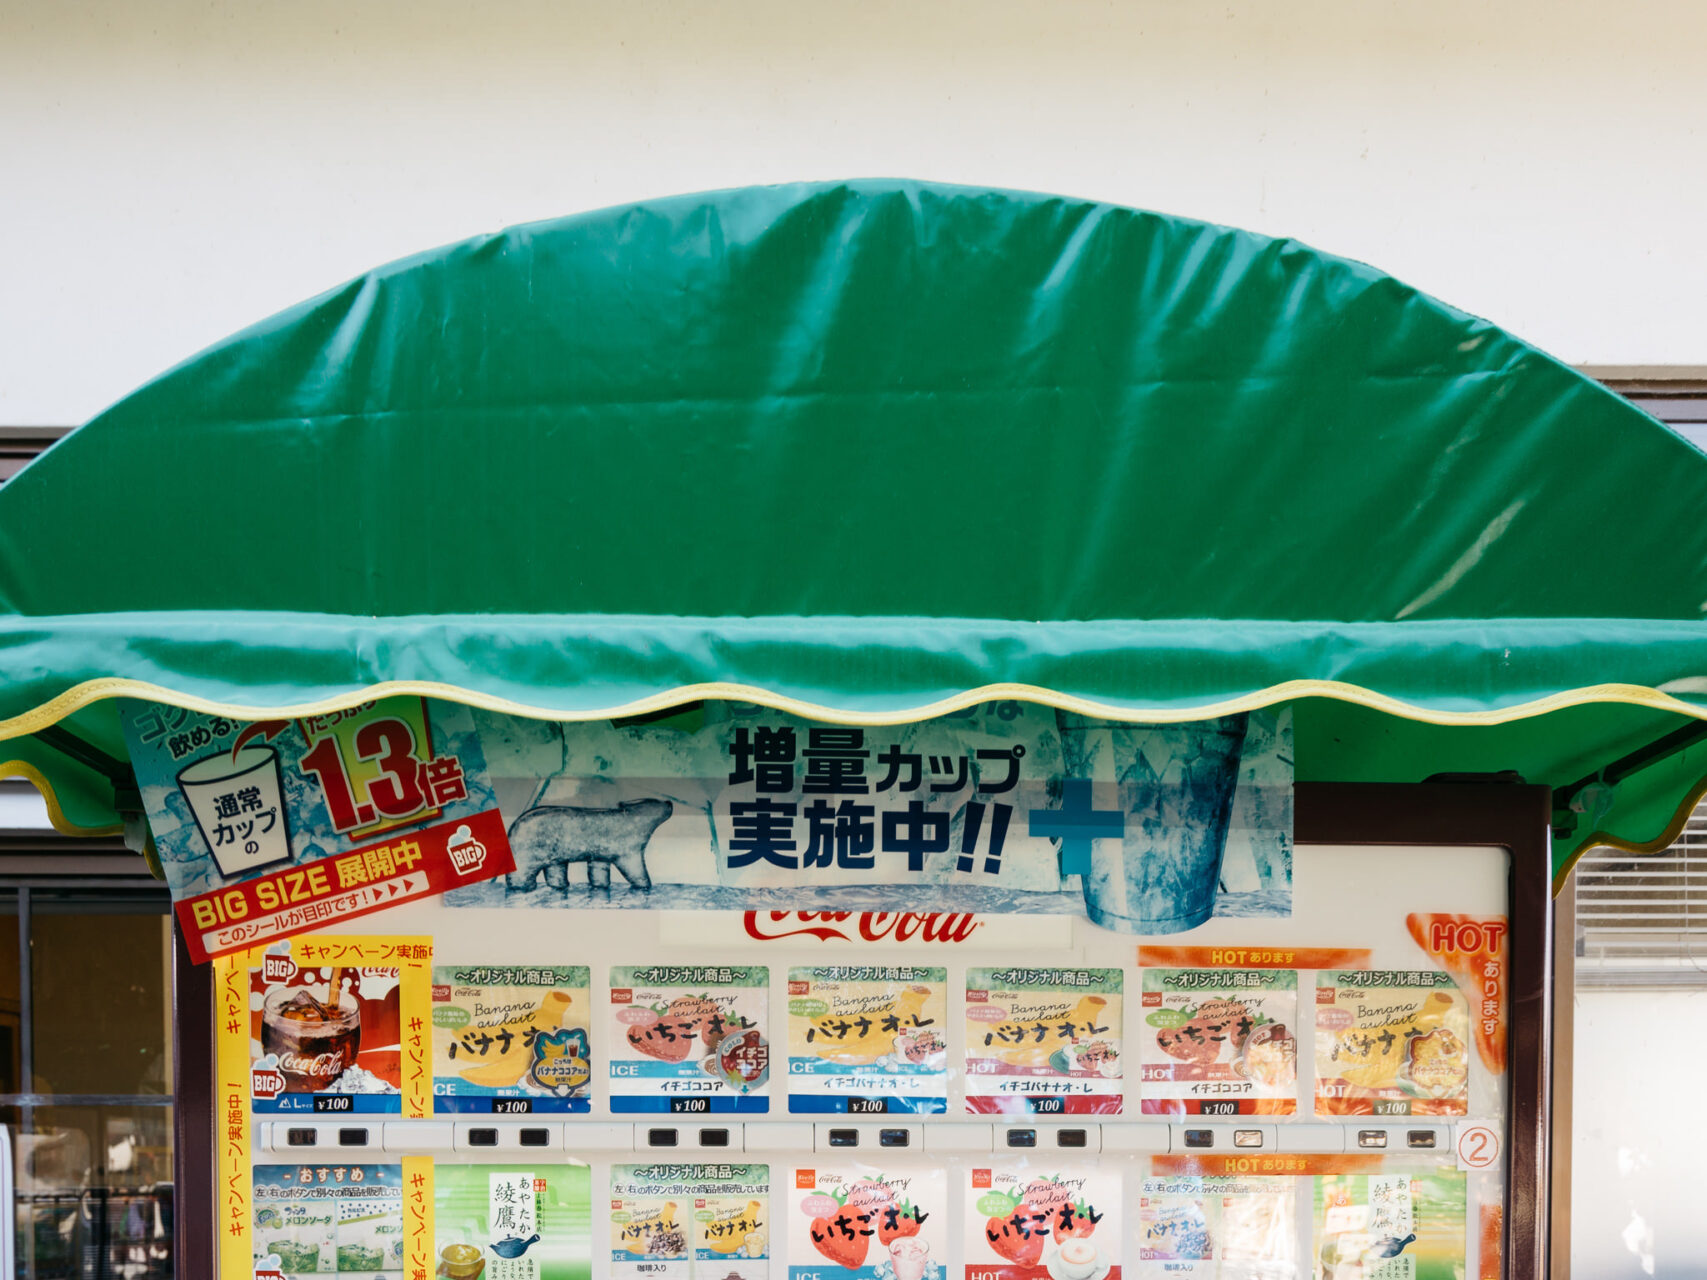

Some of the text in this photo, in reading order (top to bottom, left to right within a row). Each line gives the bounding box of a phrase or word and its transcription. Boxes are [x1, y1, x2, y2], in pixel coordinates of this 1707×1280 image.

[728, 726, 1027, 795] 増量カップ
[212, 786, 262, 820] 通常
[211, 806, 277, 847] カップ
[243, 840, 259, 855] の
[452, 846, 477, 869] BIG
[192, 840, 424, 930] BIG SIZE 展開中
[1431, 922, 1507, 954] HOT
[473, 1002, 537, 1017] Banana
[661, 994, 738, 1010] Strawberry
[1484, 962, 1499, 1036] あります
[278, 1051, 343, 1077] Coca-Cola
[611, 1065, 639, 1076] ICE
[660, 1081, 724, 1092] イチゴココア
[317, 1097, 350, 1111] ¥100
[1376, 1103, 1407, 1115] ¥100
[299, 1167, 365, 1184] おすすめ
[494, 1182, 517, 1232] 綾鷹
[518, 1177, 532, 1235] あやたか
